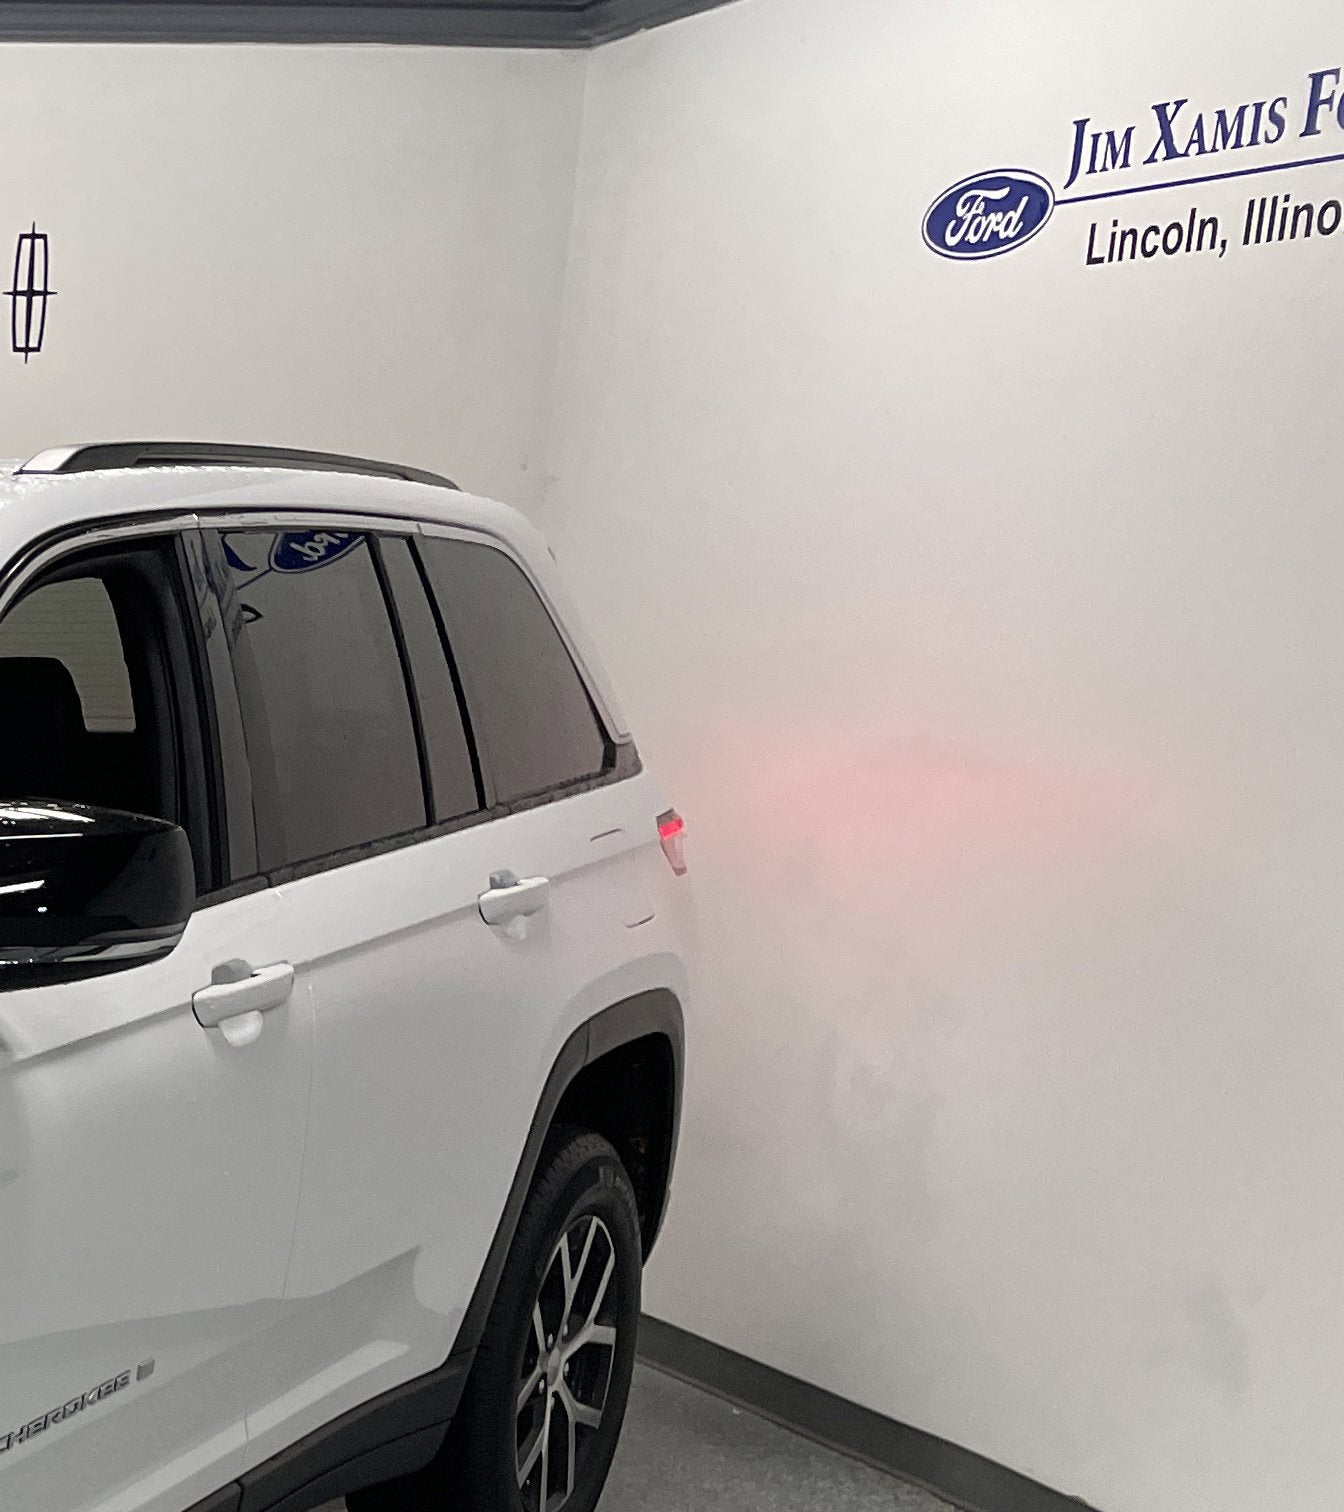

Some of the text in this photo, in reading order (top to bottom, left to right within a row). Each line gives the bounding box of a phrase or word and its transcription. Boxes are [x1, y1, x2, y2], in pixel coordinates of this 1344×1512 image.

[1063, 66, 1344, 190] JIM XAMIS F
[944, 185, 1030, 247] Ford
[1085, 193, 1344, 266] Lincoln, Illino
